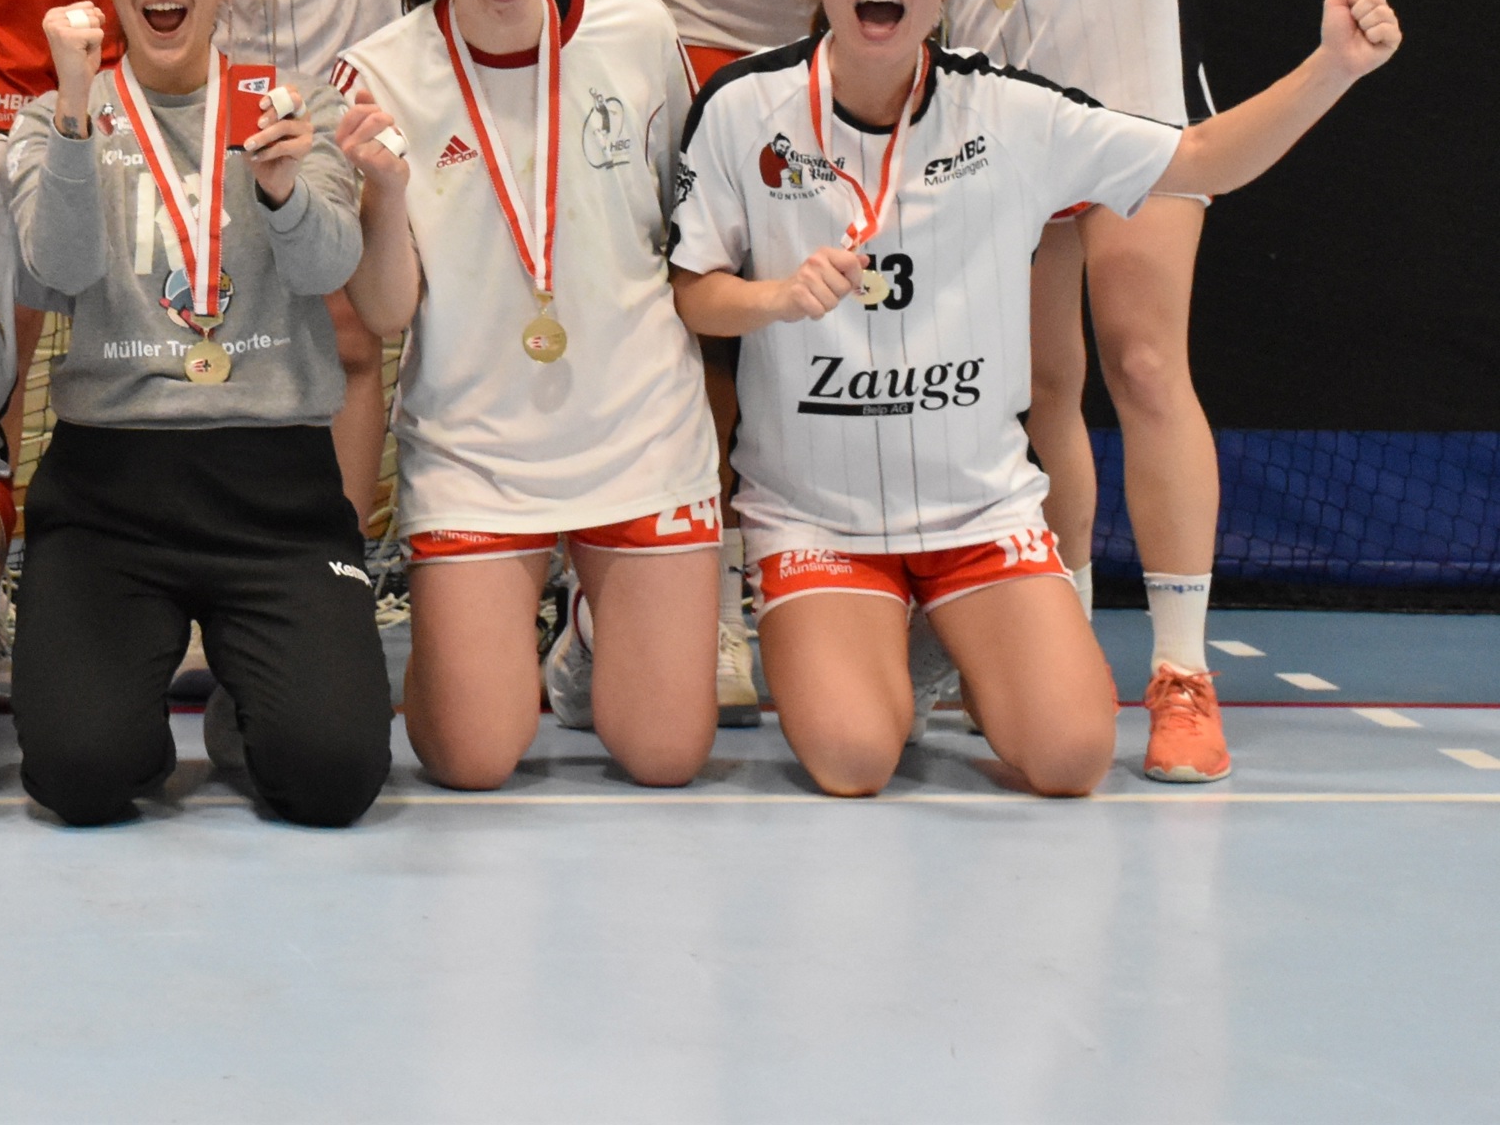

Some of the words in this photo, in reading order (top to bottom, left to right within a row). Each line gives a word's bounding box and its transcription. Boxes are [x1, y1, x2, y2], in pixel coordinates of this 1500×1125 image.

[610, 139, 631, 152] HBC
[437, 150, 478, 168] adidas
[809, 167, 837, 182] Pub
[103, 339, 161, 359] Müller
[808, 355, 985, 411] Zaugg
[862, 404, 888, 416] Belp
[890, 402, 909, 414] AG
